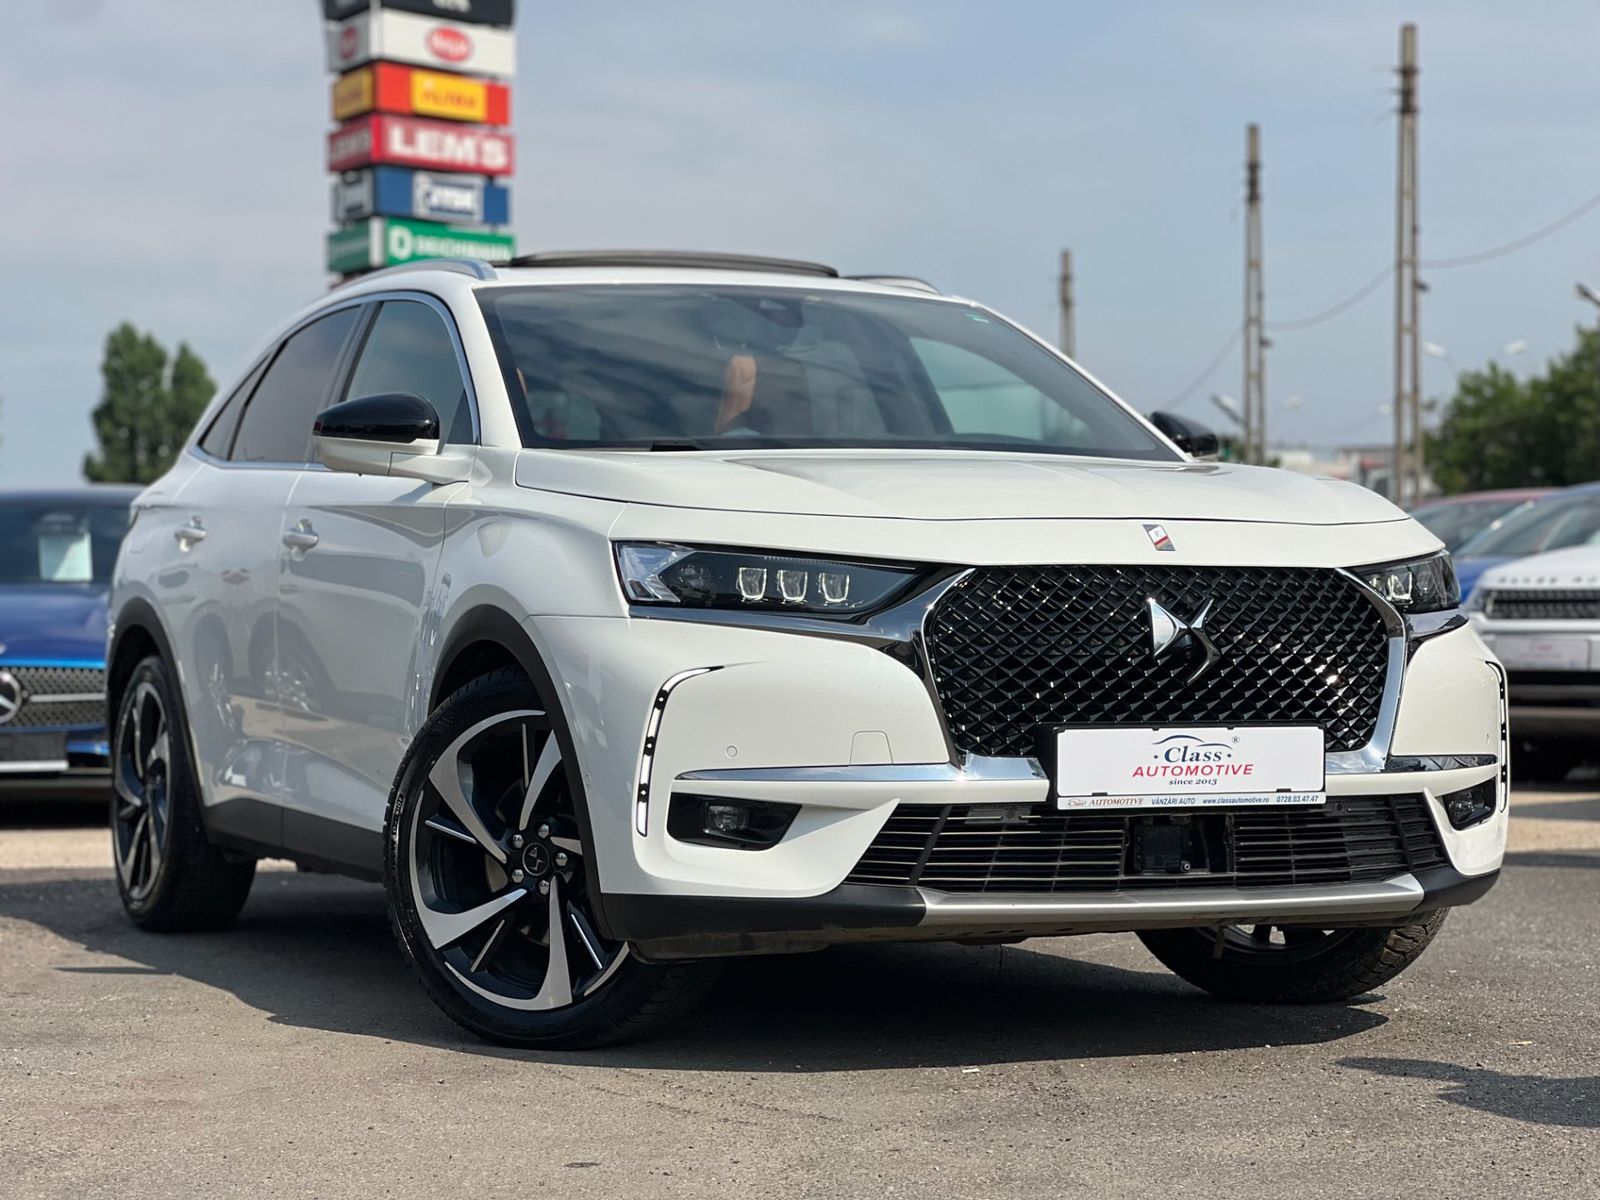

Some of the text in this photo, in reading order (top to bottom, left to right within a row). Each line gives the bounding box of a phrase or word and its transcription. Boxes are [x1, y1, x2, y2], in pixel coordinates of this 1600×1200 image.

[1164, 745, 1223, 763] Class
[1132, 763, 1254, 778] AUTOMOTIVE
[1168, 777, 1218, 786] since 2013
[1090, 797, 1145, 806] AUTOMOTIVE
[1179, 797, 1196, 805] AUTO
[1202, 796, 1270, 805] www.classautomotive.ro
[1276, 795, 1319, 804] 0728.03.47.47
